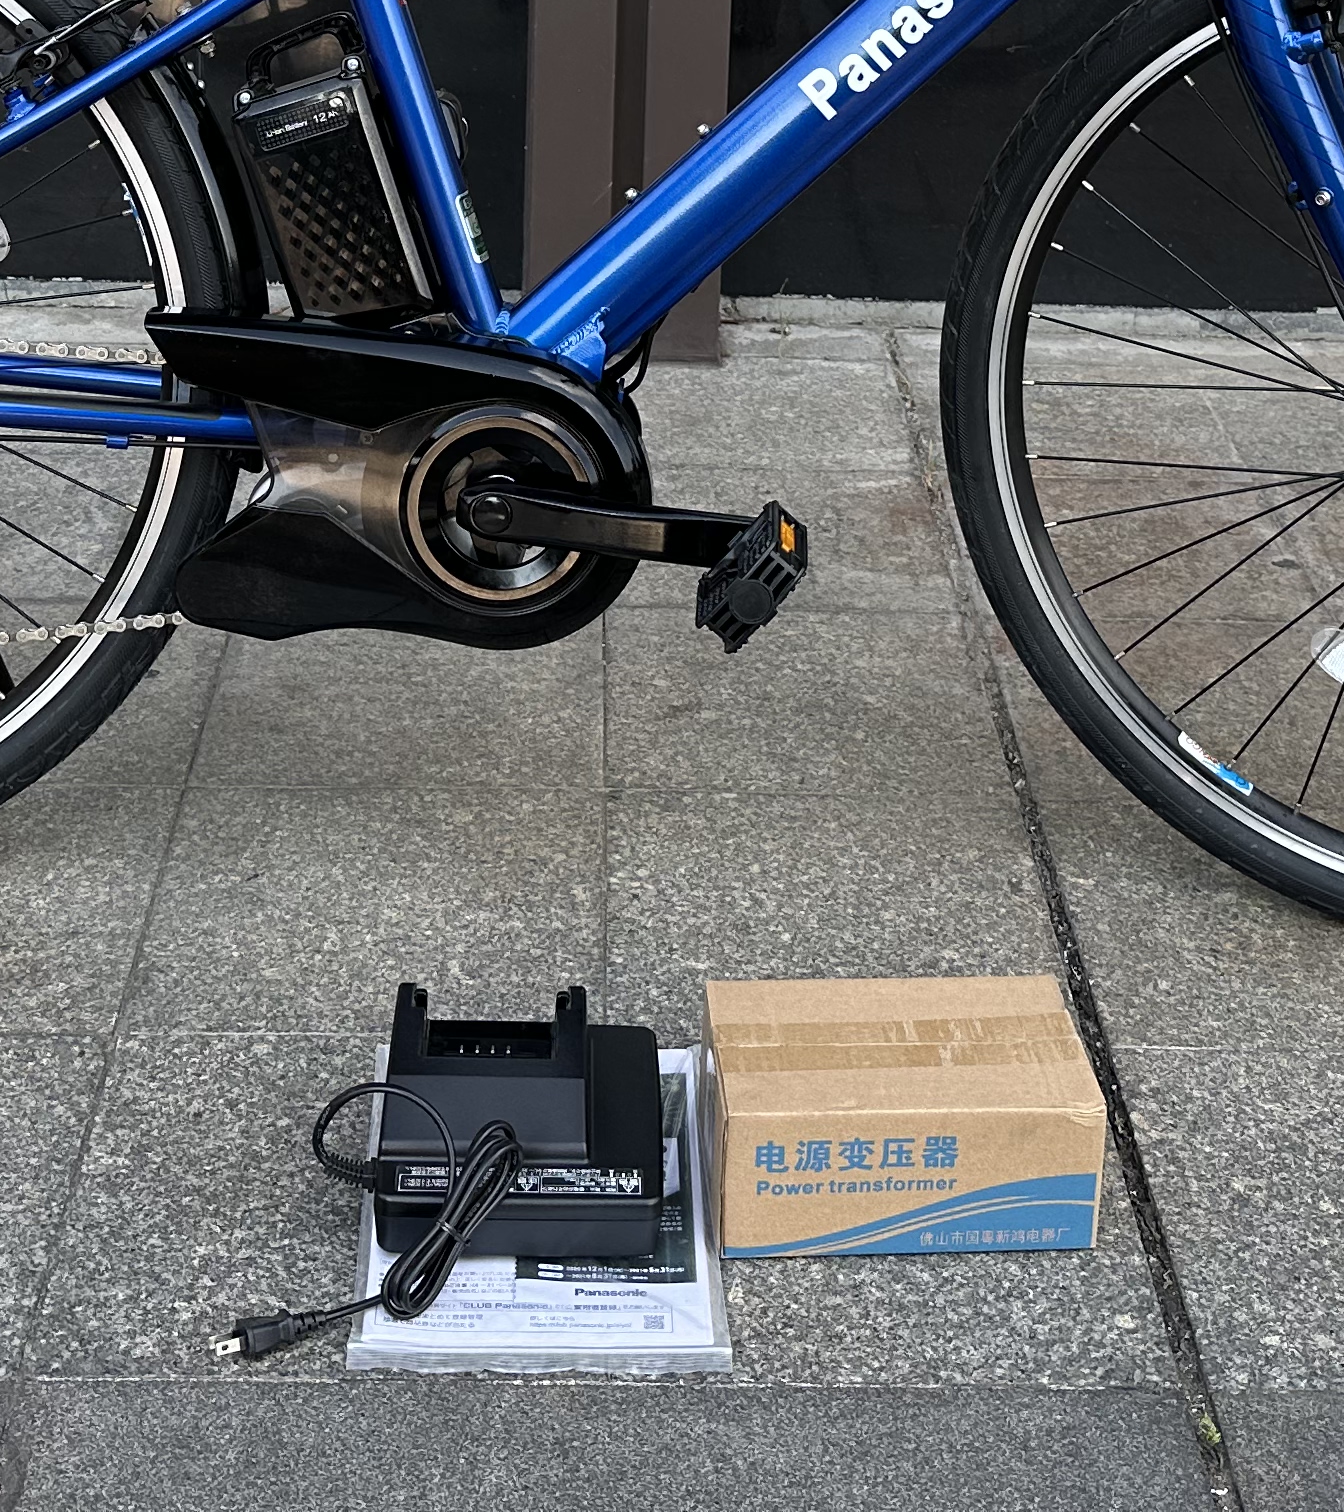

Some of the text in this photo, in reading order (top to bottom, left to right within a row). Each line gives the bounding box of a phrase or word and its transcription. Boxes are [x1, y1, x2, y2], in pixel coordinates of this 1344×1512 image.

[313, 112, 327, 123] 12
[754, 1136, 959, 1174] 电源变压器
[756, 1176, 958, 1196] Power transformer
[574, 1287, 649, 1298] Panasonic
